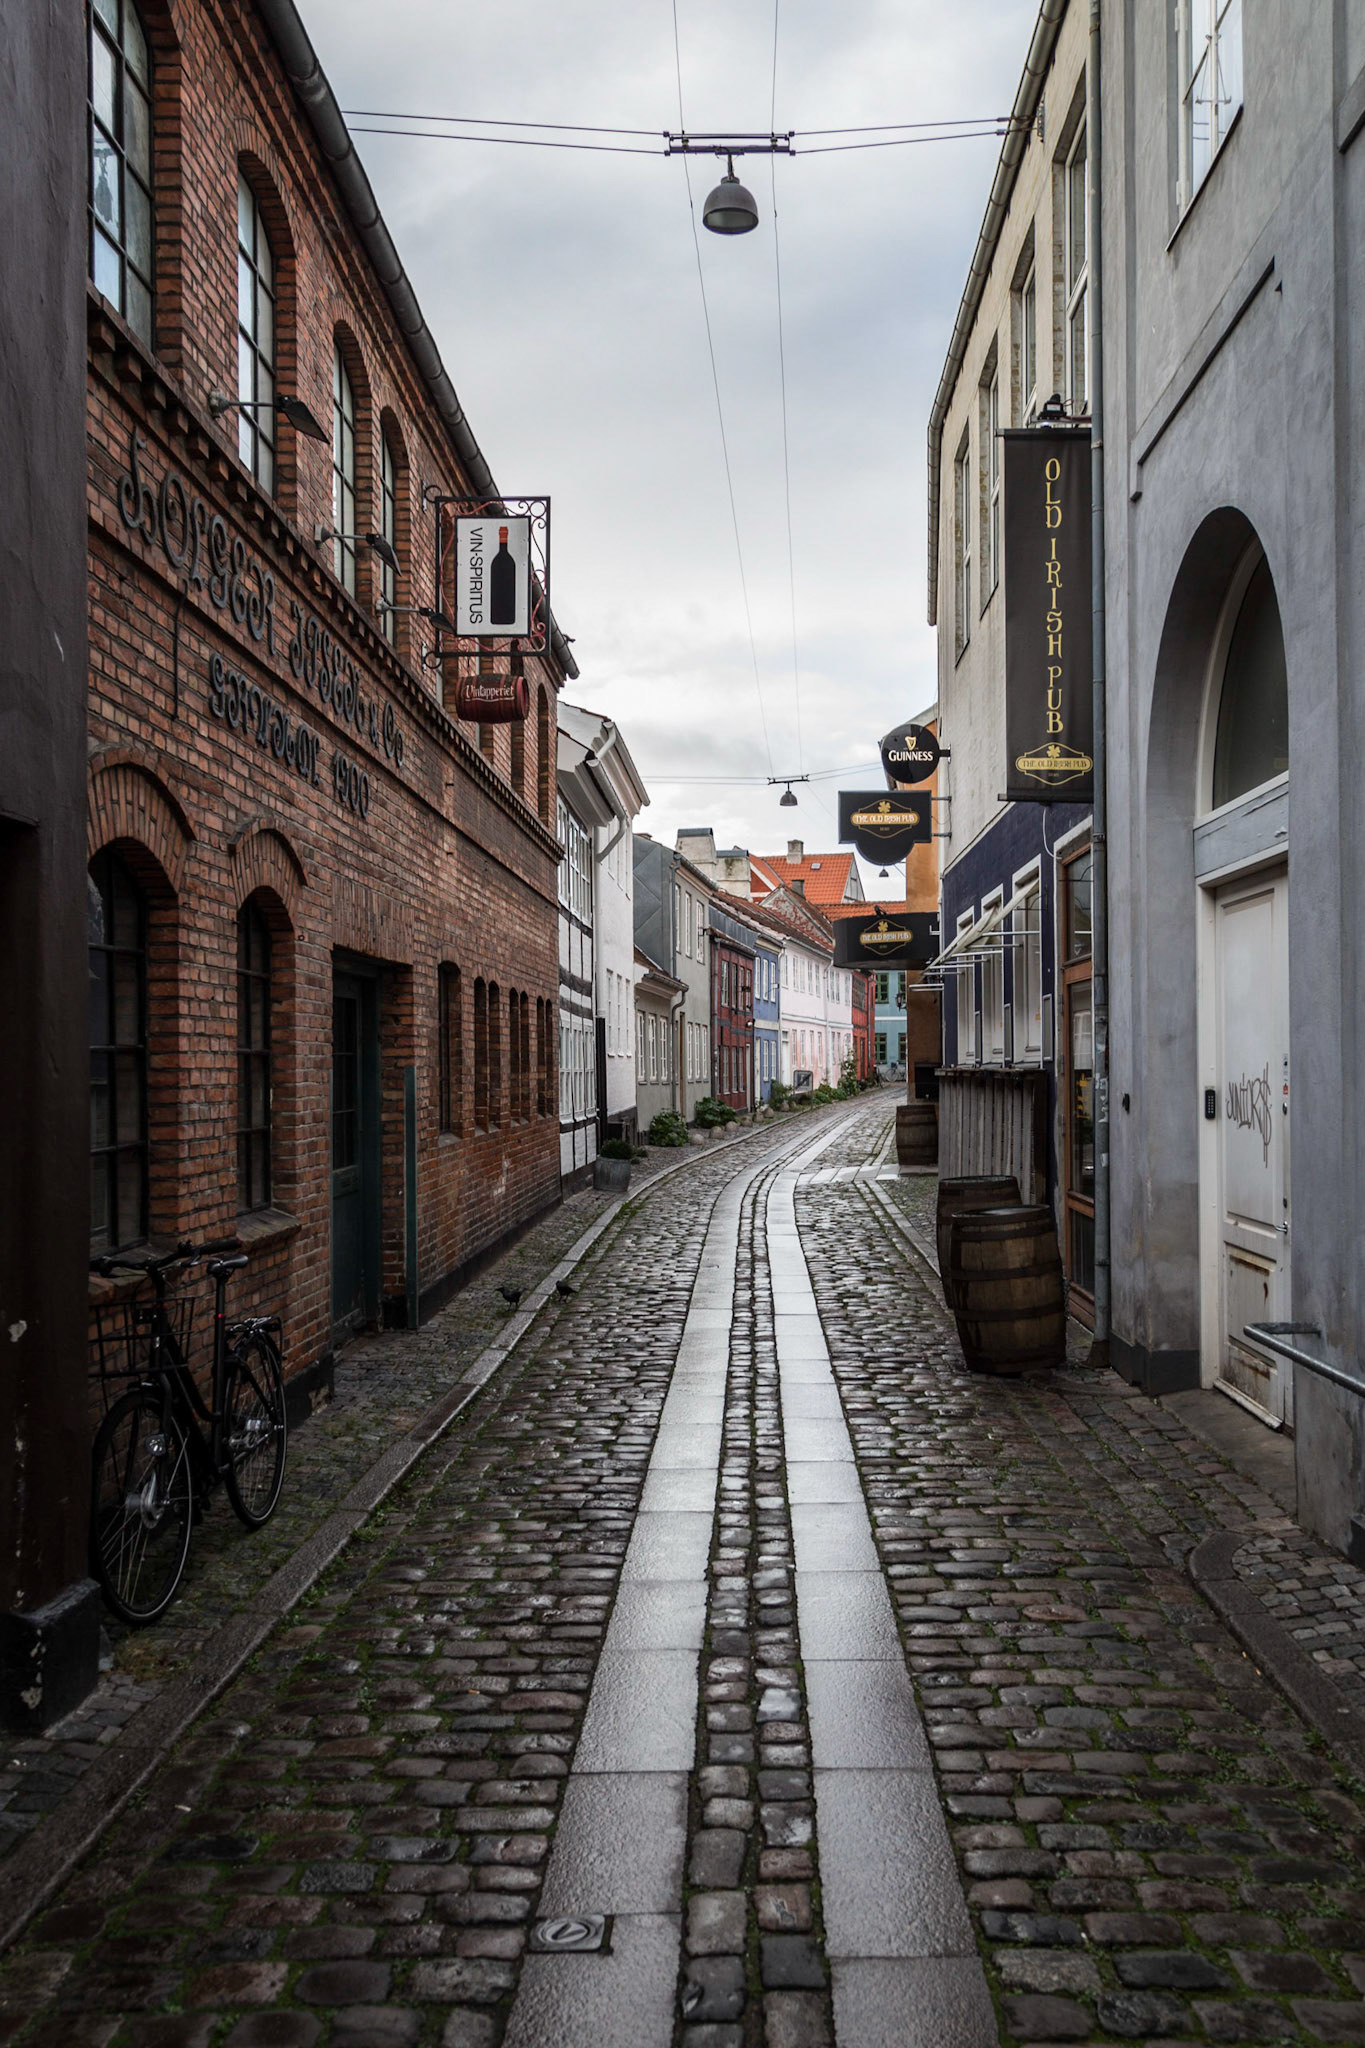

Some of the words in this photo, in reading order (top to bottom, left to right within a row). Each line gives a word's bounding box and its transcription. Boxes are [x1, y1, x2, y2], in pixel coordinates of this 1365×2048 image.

[1045, 457, 1063, 529] OLD
[1045, 537, 1063, 659] IRISH
[466, 684, 514, 700] Vintapperiet
[1046, 666, 1064, 734] PUB
[888, 749, 934, 762] GUINNESS
[1023, 760, 1036, 768] THE
[1038, 760, 1053, 768] OLD
[1053, 760, 1072, 769] IRISH
[1073, 760, 1087, 768] PUB
[332, 749, 370, 818] 1900
[856, 815, 868, 823] THE
[870, 815, 883, 823] OLD
[884, 815, 901, 824] IRISH
[902, 814, 915, 822] PUB
[883, 933, 897, 941] IRISH
[897, 932, 909, 940] PUB
